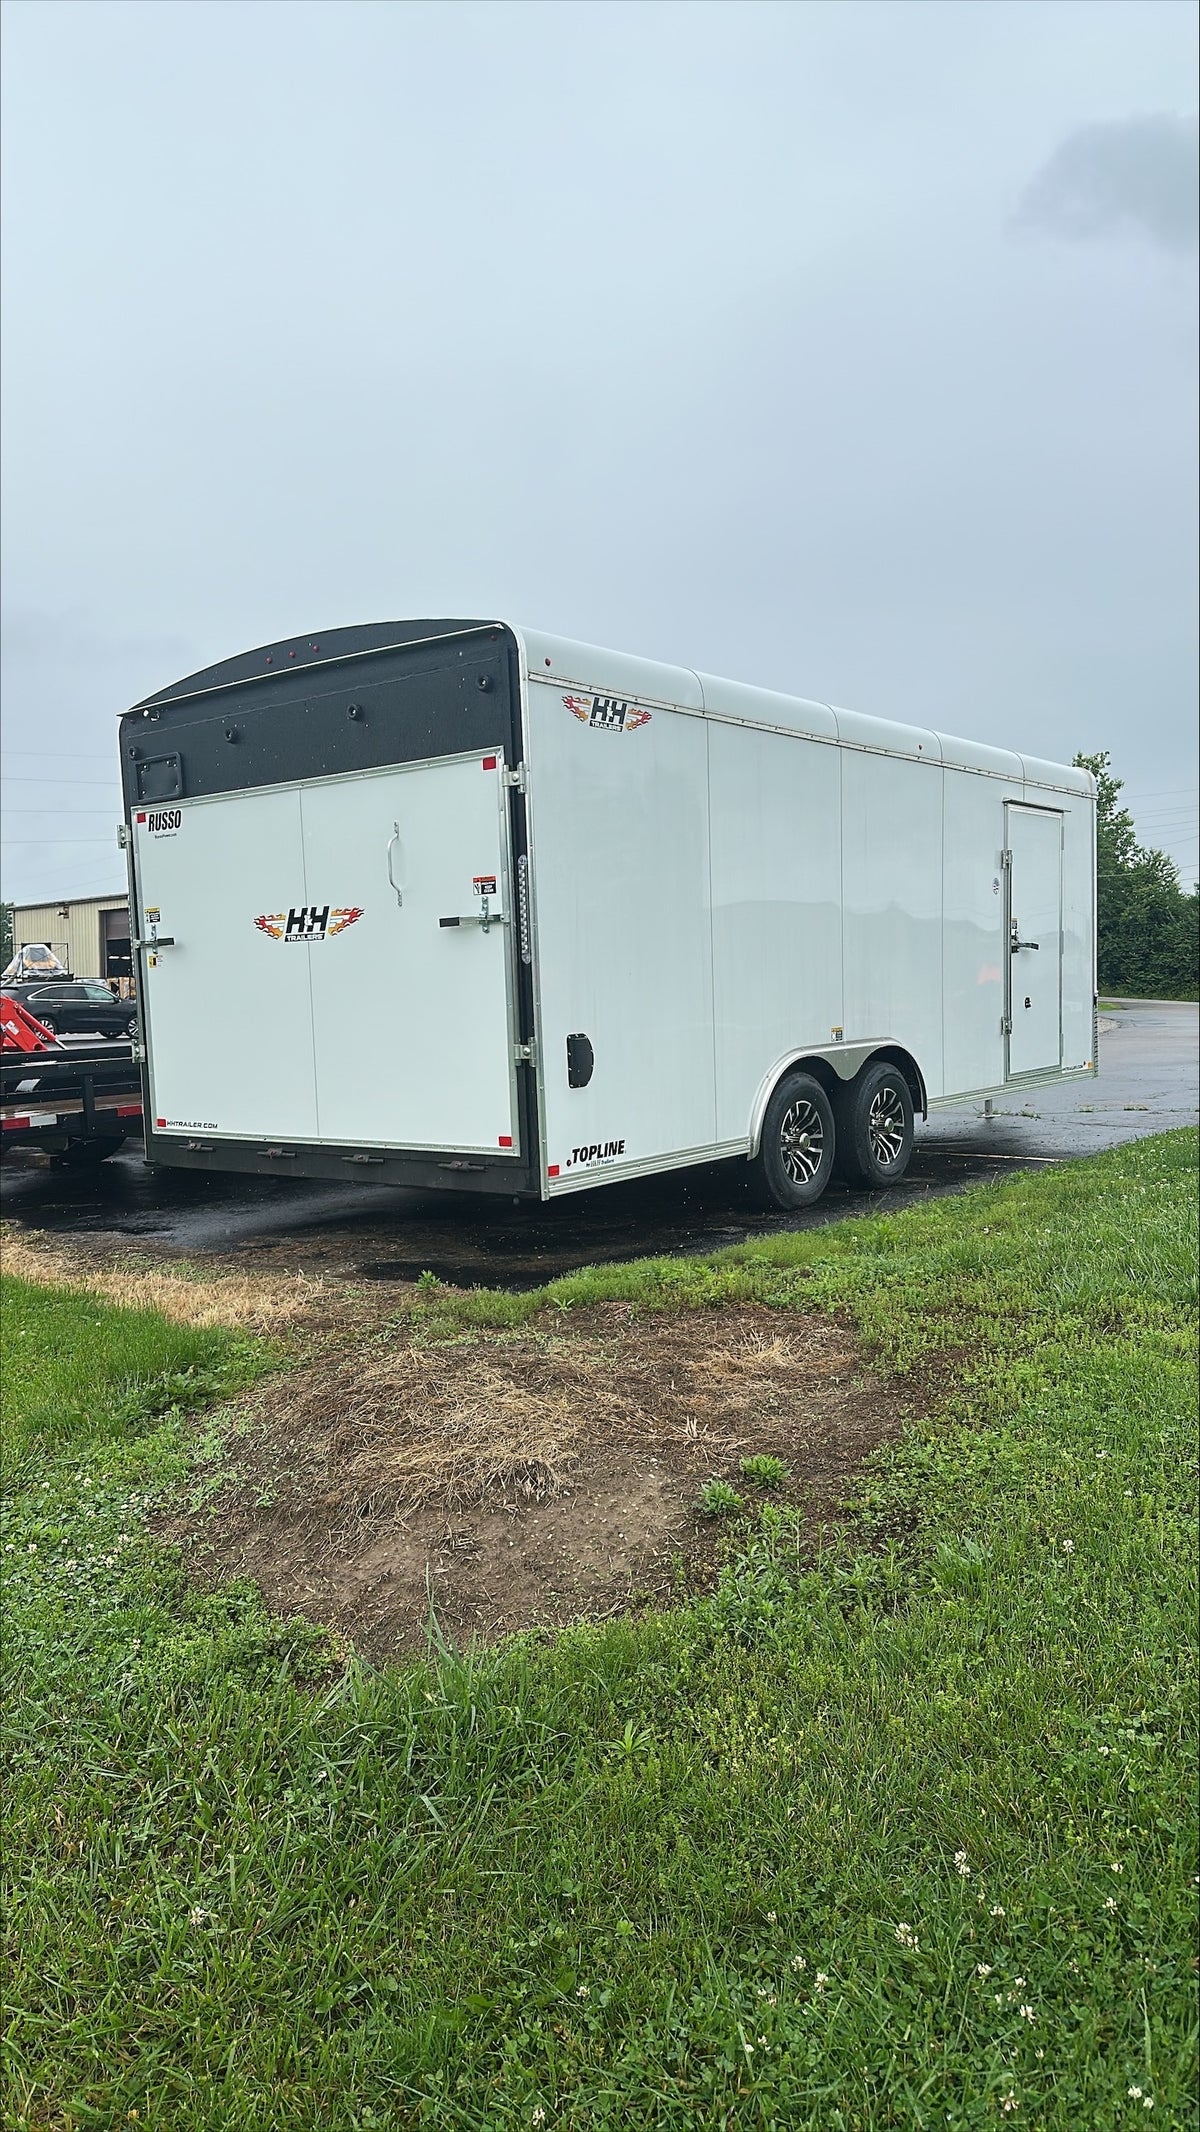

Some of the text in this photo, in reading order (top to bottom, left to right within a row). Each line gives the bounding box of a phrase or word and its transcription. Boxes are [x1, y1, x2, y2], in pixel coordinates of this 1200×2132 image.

[590, 720, 623, 732] TRAILERS
[148, 810, 182, 832] RUSSO
[286, 933, 324, 942] TRAILERS
[167, 1121, 218, 1129] HHTRAILER.COM
[572, 1139, 625, 1164] TOPLINE
